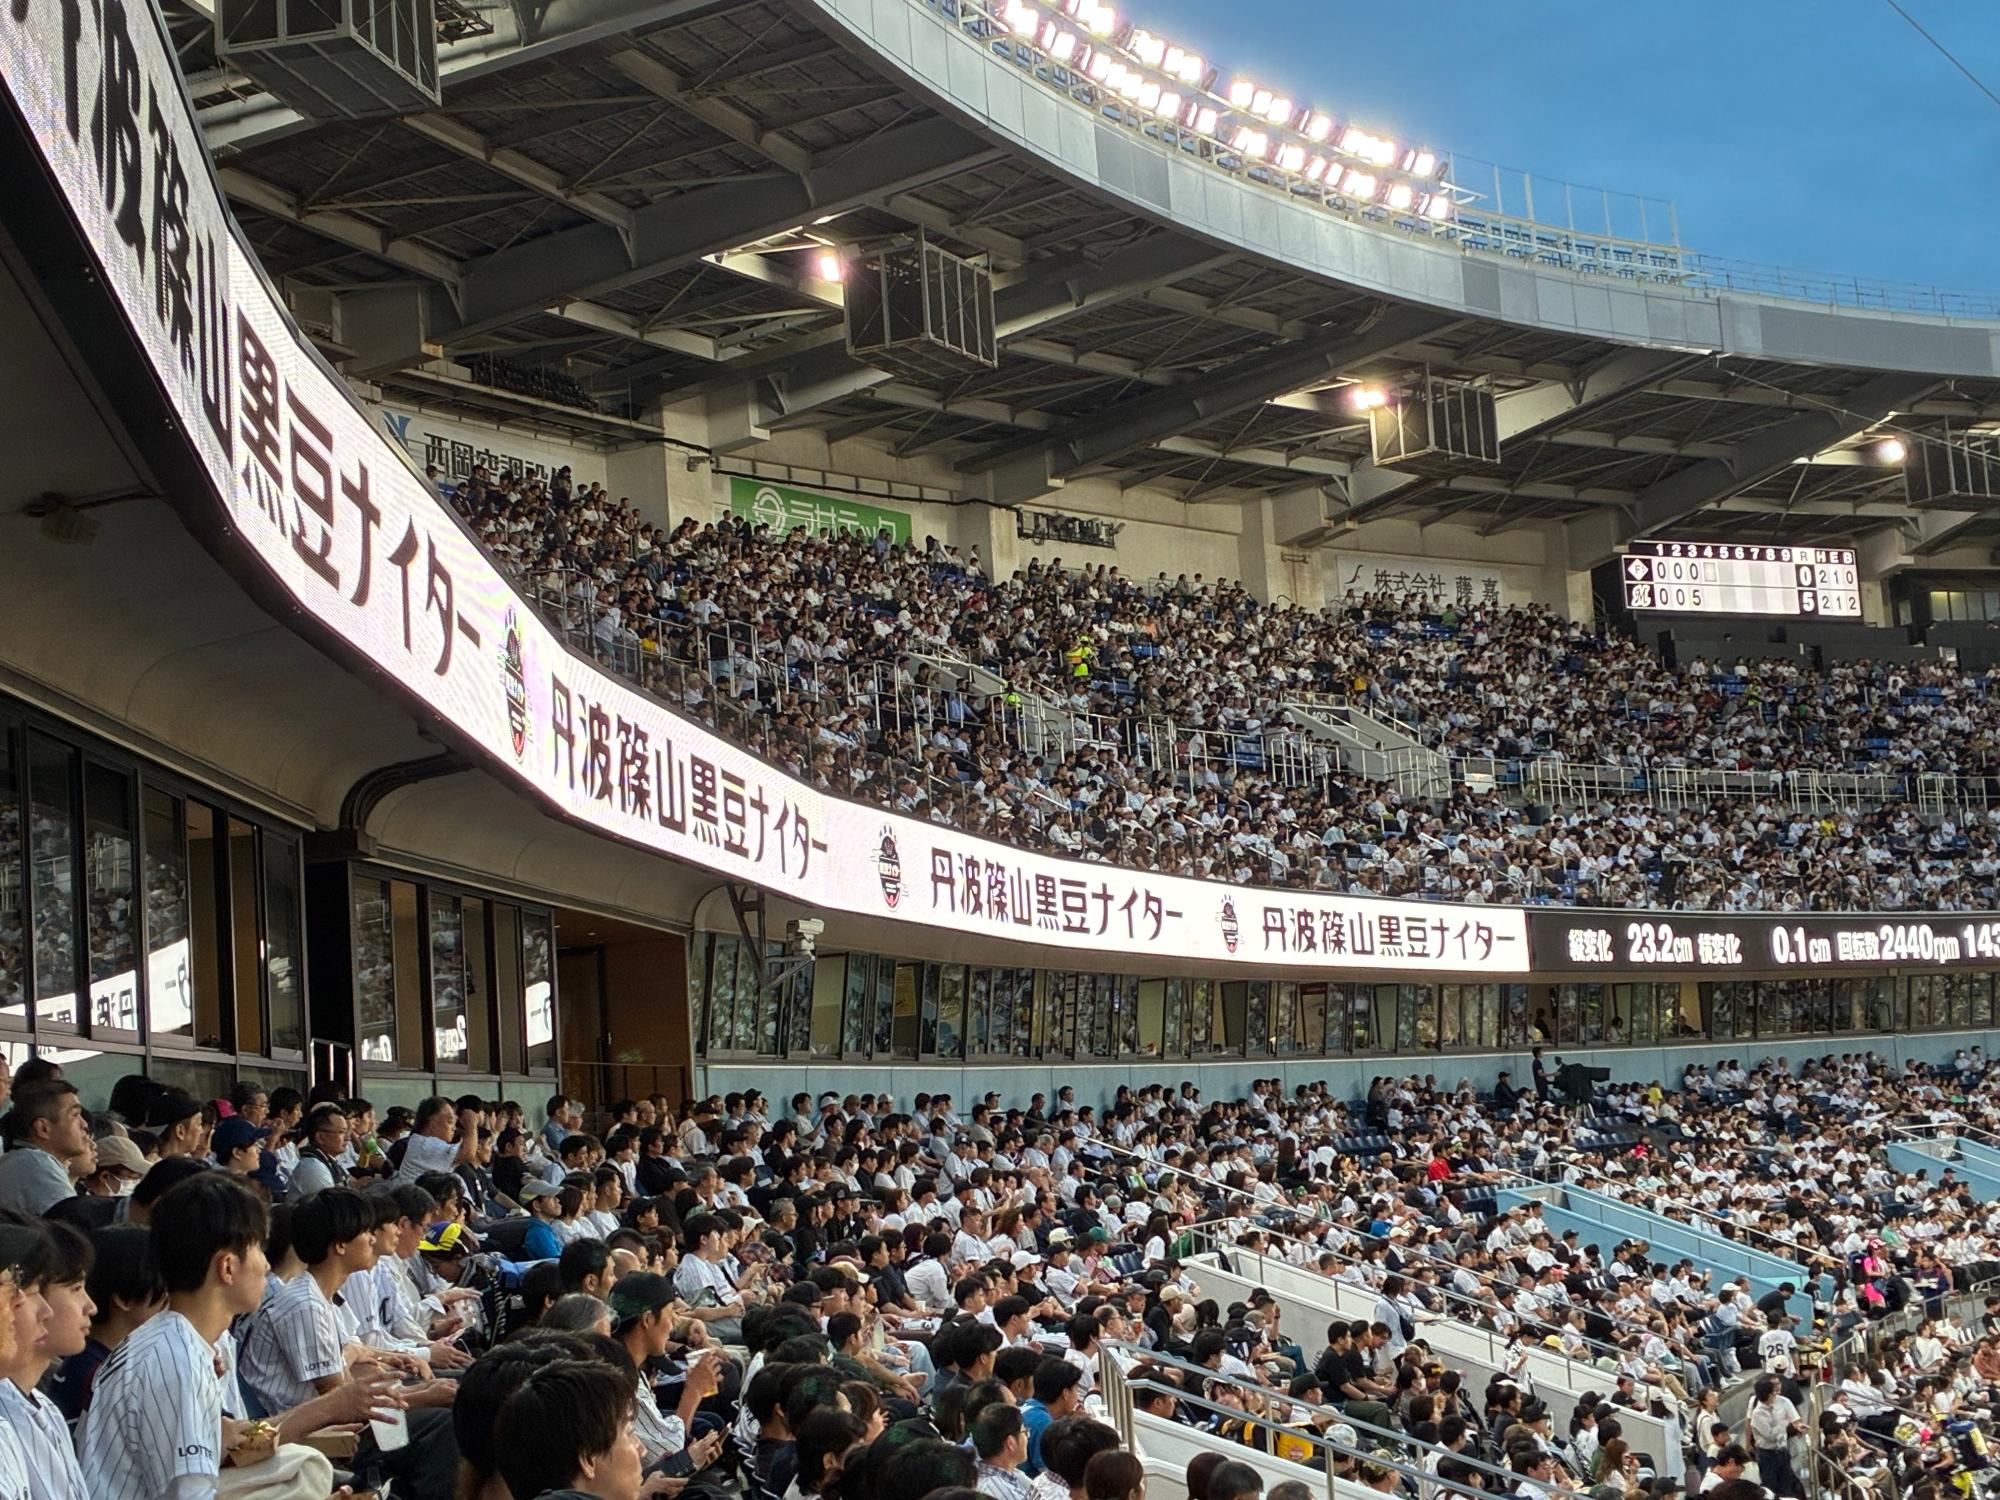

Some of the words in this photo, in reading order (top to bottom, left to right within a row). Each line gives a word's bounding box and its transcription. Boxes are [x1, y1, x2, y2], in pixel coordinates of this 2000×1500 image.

[1656, 543, 1664, 556] 1
[1671, 544, 1682, 557] 2
[1687, 544, 1698, 558] 3
[1703, 545, 1713, 558] 4
[1719, 546, 1729, 559] 5
[1735, 546, 1745, 560] 6
[1750, 547, 1760, 560] 7
[1766, 548, 1776, 561] 8
[1781, 548, 1791, 562] 9
[1800, 551, 1808, 561] R
[1816, 550, 1827, 563] H
[1830, 551, 1839, 563] E
[1843, 551, 1853, 564] B
[1374, 568, 1447, 598] 株式会社
[1657, 562, 1666, 579] 0
[1674, 562, 1683, 579] 0
[1689, 563, 1699, 580] 0
[1799, 565, 1812, 587] 0
[1819, 569, 1828, 584] 2
[1833, 569, 1839, 585] 1
[1846, 570, 1854, 585] 0
[1660, 588, 1669, 605] 0
[1676, 588, 1685, 605] 0
[1692, 589, 1702, 606] 5
[1802, 591, 1815, 612] 5
[1821, 595, 1830, 609] 2
[1836, 596, 1842, 610] 1
[1848, 596, 1857, 610] 2
[551, 671, 828, 880] 丹波篠山黒豆ナイター
[931, 846, 1184, 941] 丹波篠山黒豆ナイター
[1262, 906, 1516, 961] 丹波篠山黒豆ナイター
[178, 1444, 214, 1461] LOTTE
